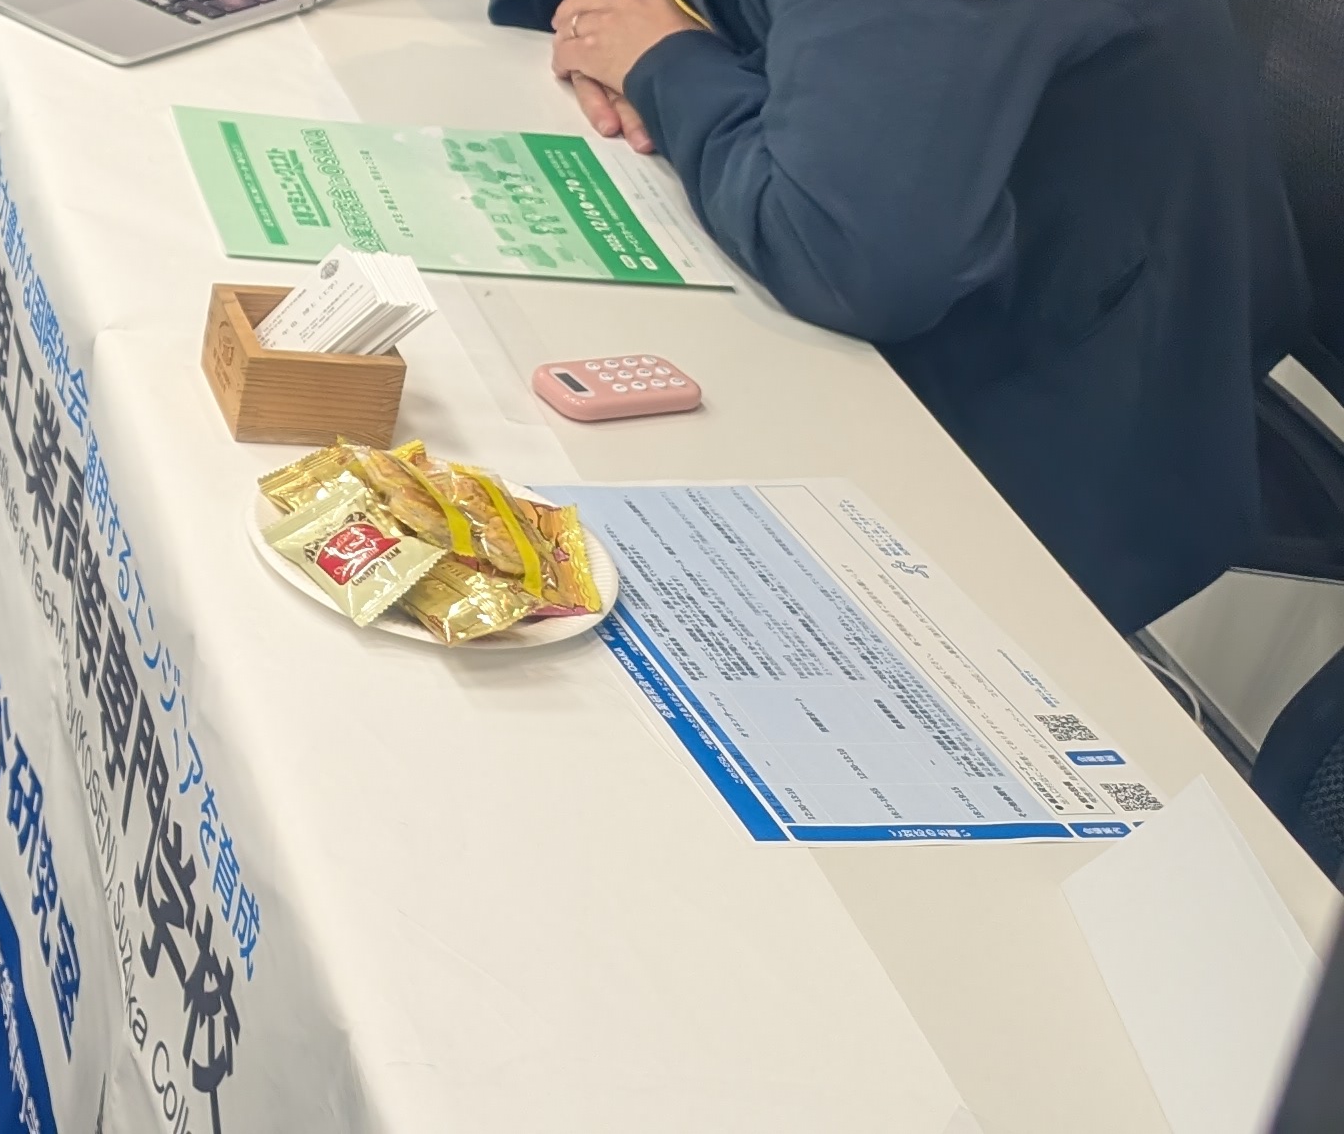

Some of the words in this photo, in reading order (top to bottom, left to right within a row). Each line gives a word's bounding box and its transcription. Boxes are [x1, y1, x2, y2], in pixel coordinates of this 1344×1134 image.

[297, 127, 347, 176] OSAKA
[611, 647, 639, 671] OSAKA
[636, 680, 678, 718] 企業研究会
[705, 691, 751, 737] オリエンテーション
[18, 525, 30, 561] of
[150, 1040, 193, 1134] Coll
